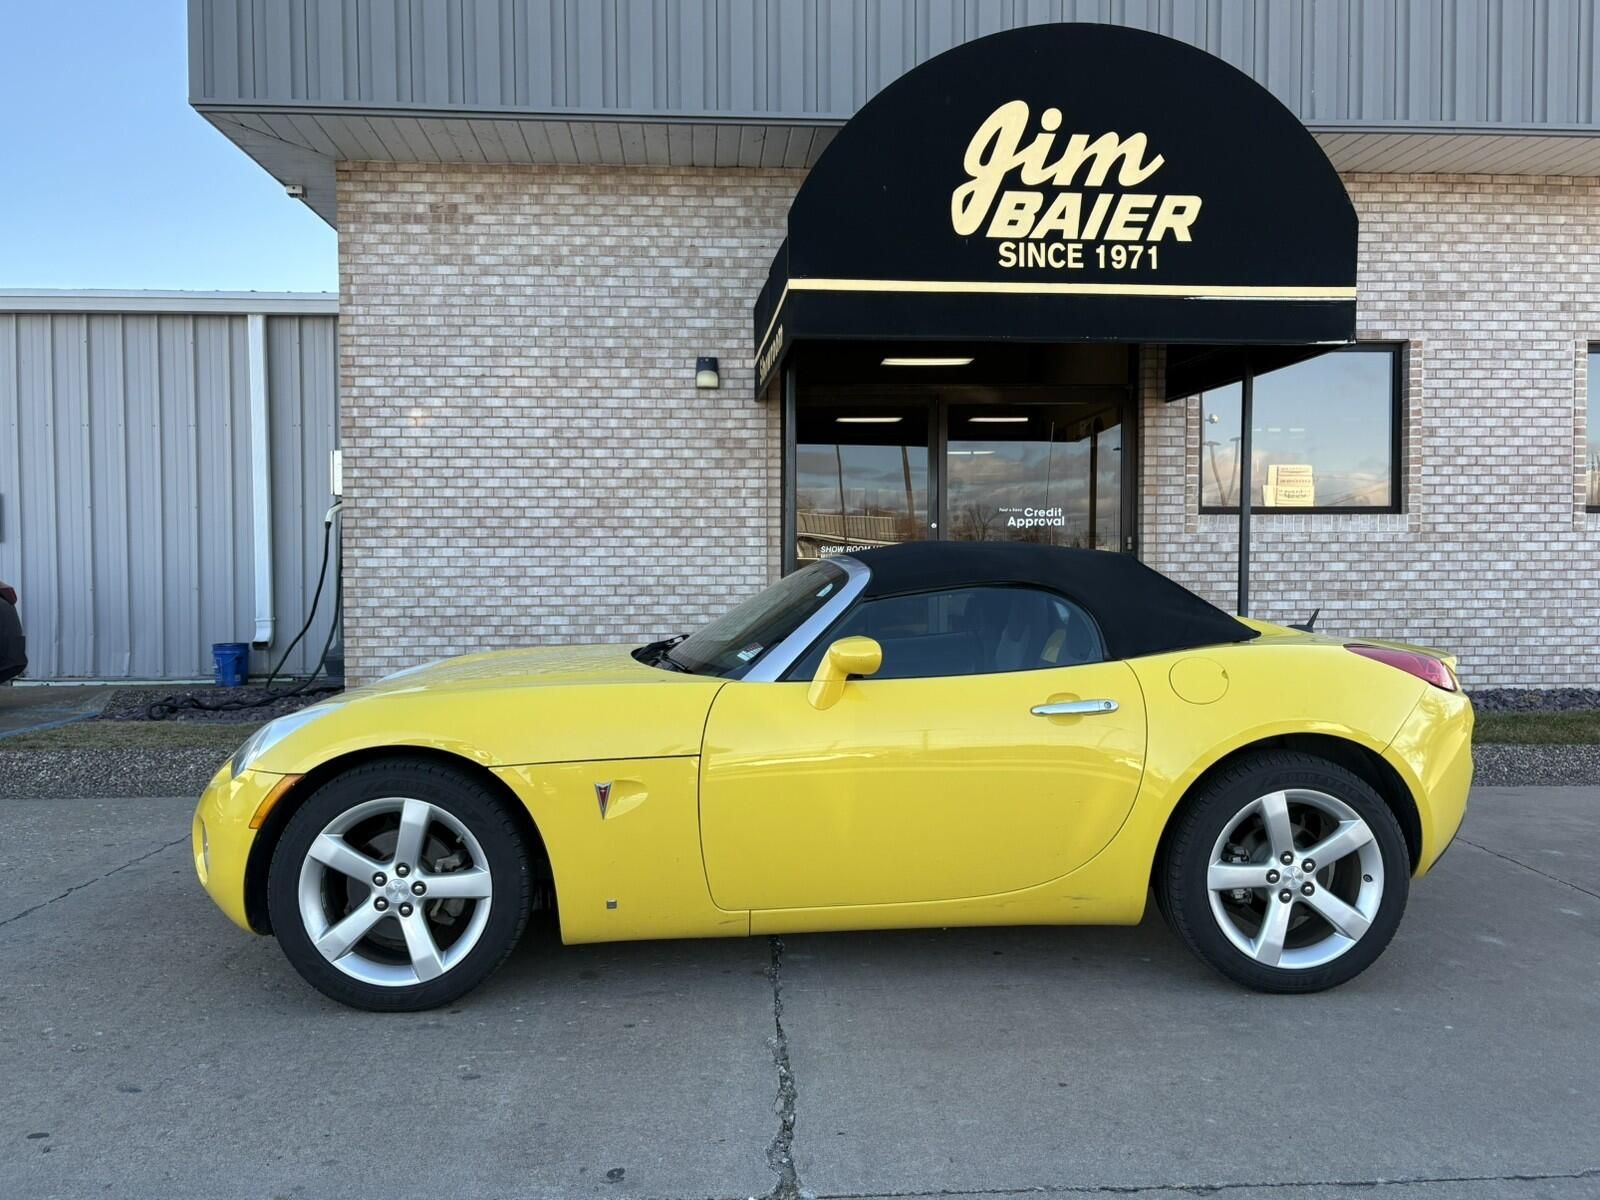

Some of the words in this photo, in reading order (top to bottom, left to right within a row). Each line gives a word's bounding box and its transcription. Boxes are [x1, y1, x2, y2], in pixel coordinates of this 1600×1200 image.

[951, 100, 1165, 236] Jim
[985, 190, 1203, 242] BAIER
[998, 241, 1084, 269] SINCE
[1096, 245, 1158, 270] 1971
[1007, 515, 1065, 529] Approval
[1024, 507, 1062, 517] Credit
[820, 545, 844, 553] SHOW
